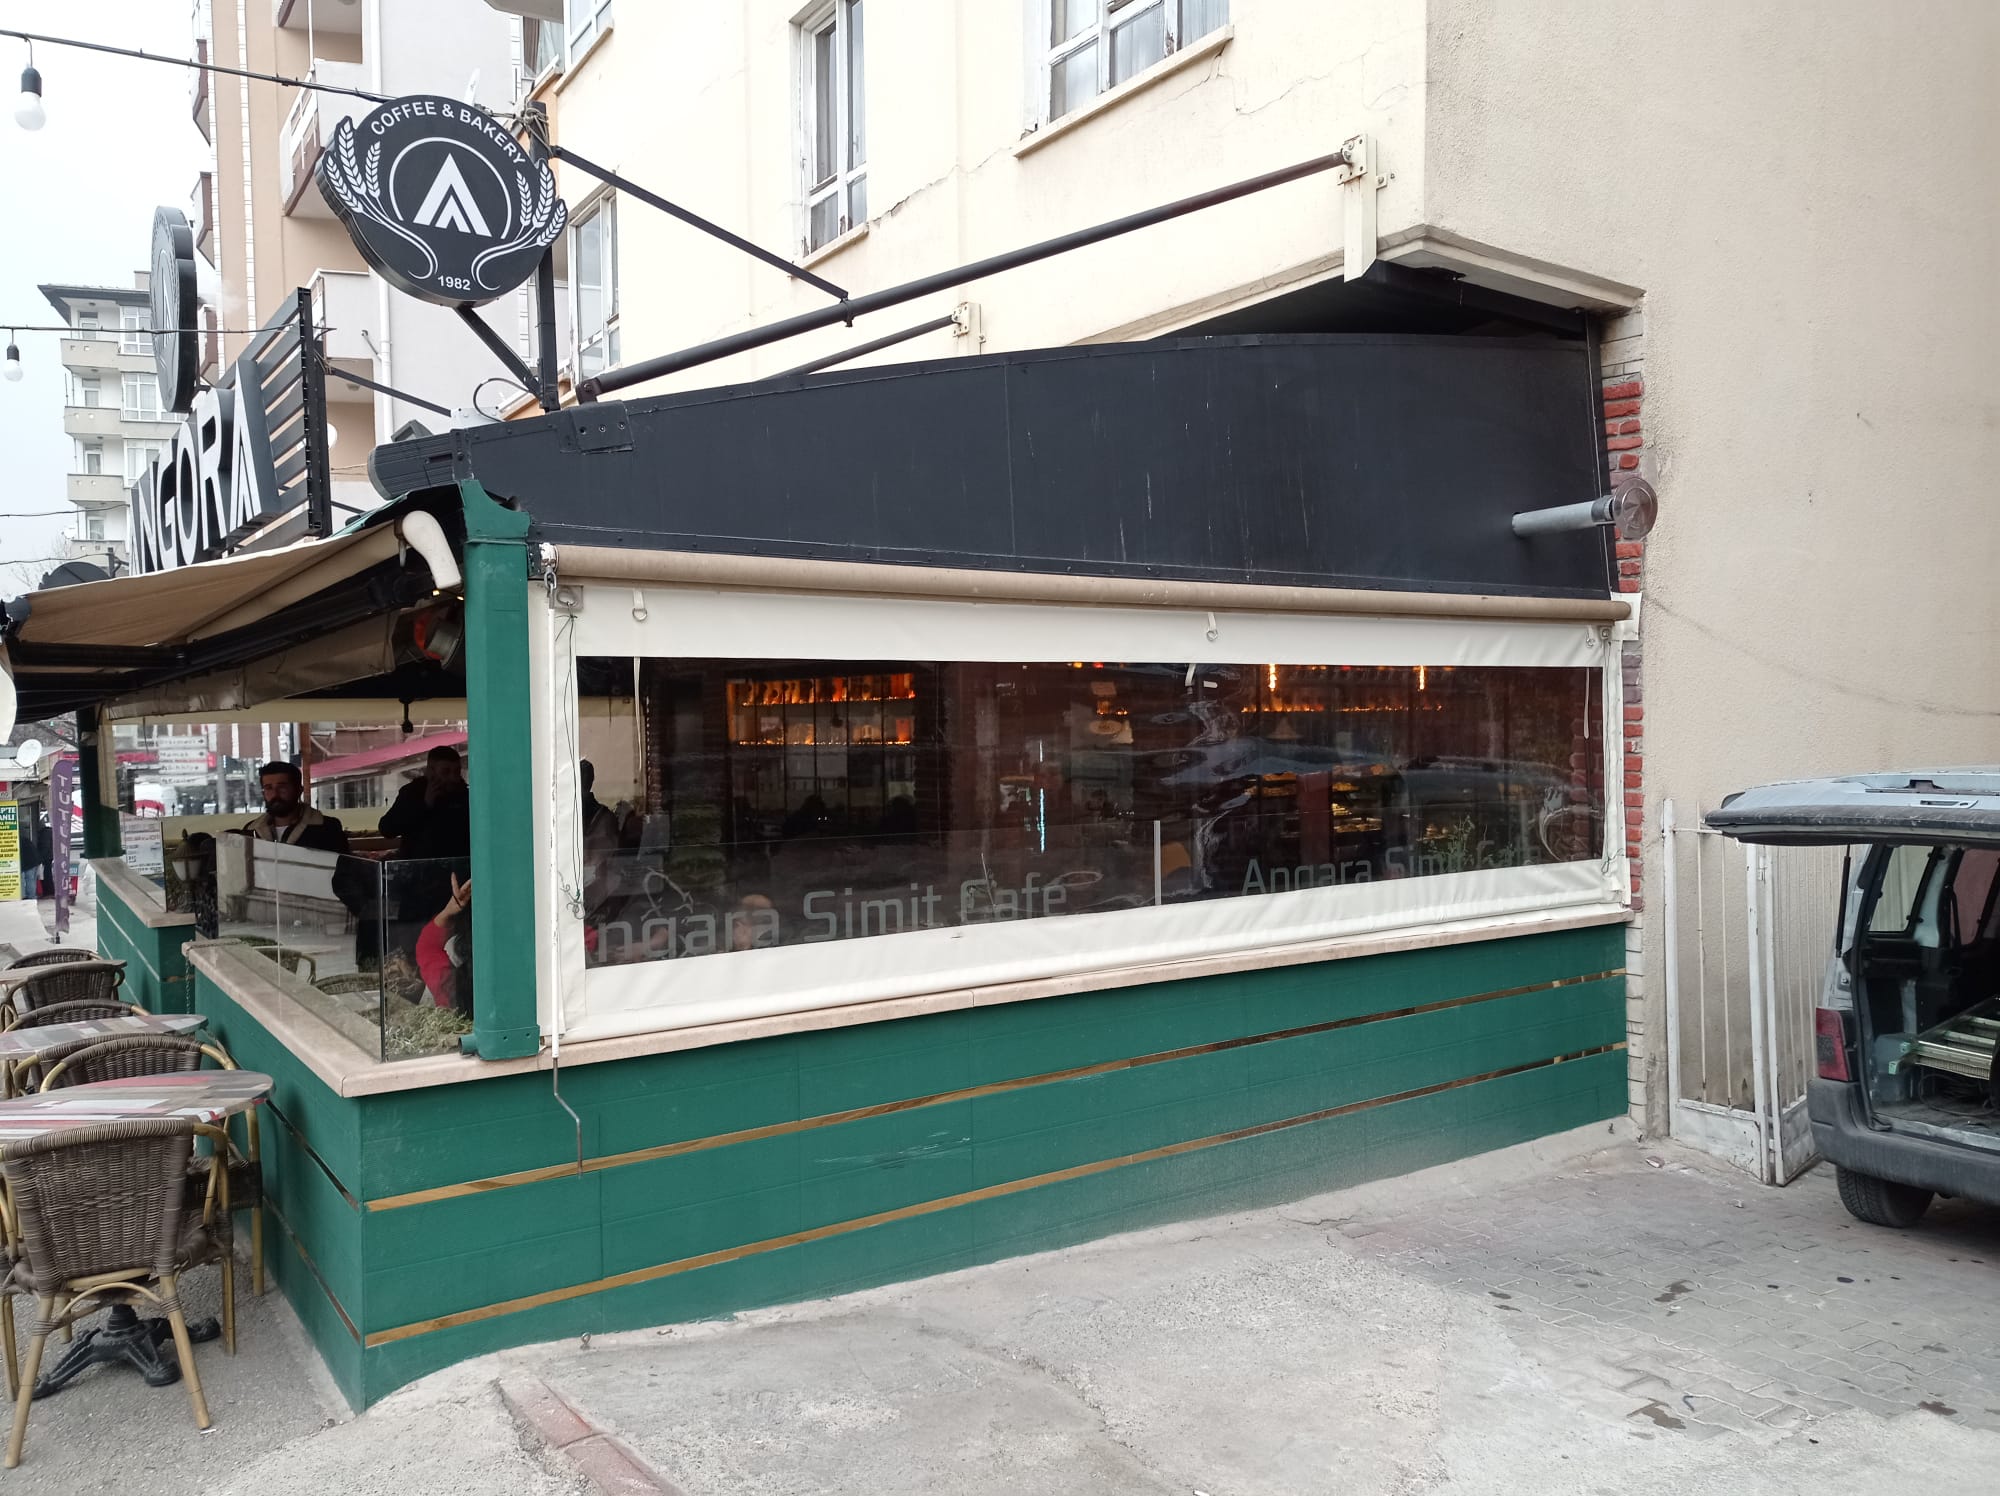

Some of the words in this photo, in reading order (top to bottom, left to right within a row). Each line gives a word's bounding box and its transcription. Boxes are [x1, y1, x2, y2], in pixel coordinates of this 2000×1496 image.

[370, 101, 437, 136] COFFEE
[442, 103, 455, 119] &
[459, 108, 527, 165] BAKERY
[437, 275, 471, 291] 1982
[1241, 858, 1373, 896] Angara
[590, 907, 780, 965] ngara
[803, 882, 942, 942] Simit
[960, 872, 1068, 923] Cafe
